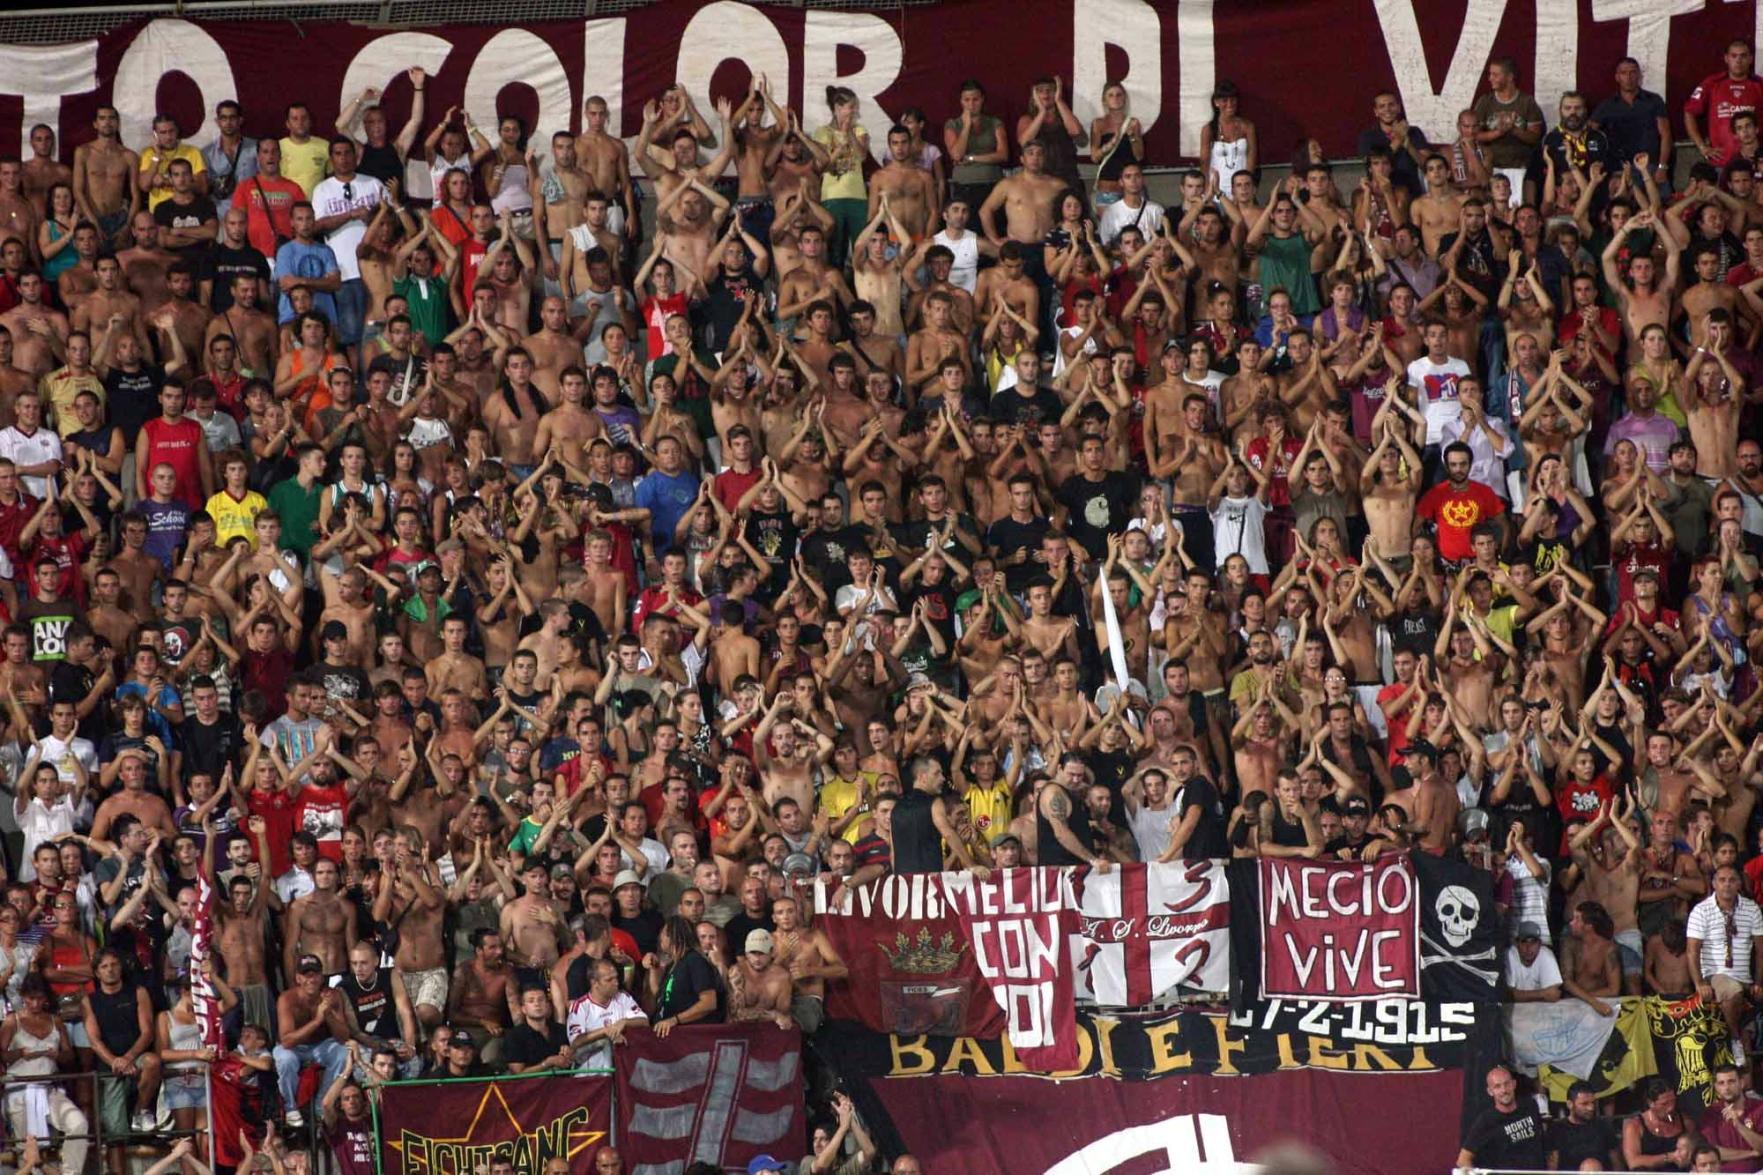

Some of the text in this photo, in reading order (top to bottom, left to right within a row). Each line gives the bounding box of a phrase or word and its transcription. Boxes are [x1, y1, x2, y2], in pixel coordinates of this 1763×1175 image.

[341, 1, 903, 199] COLOR
[1074, 0, 1215, 158] DI
[972, 913, 1061, 979] CON
[1504, 1116, 1535, 1135] NORTH
[1510, 1126, 1536, 1143] SAILS
